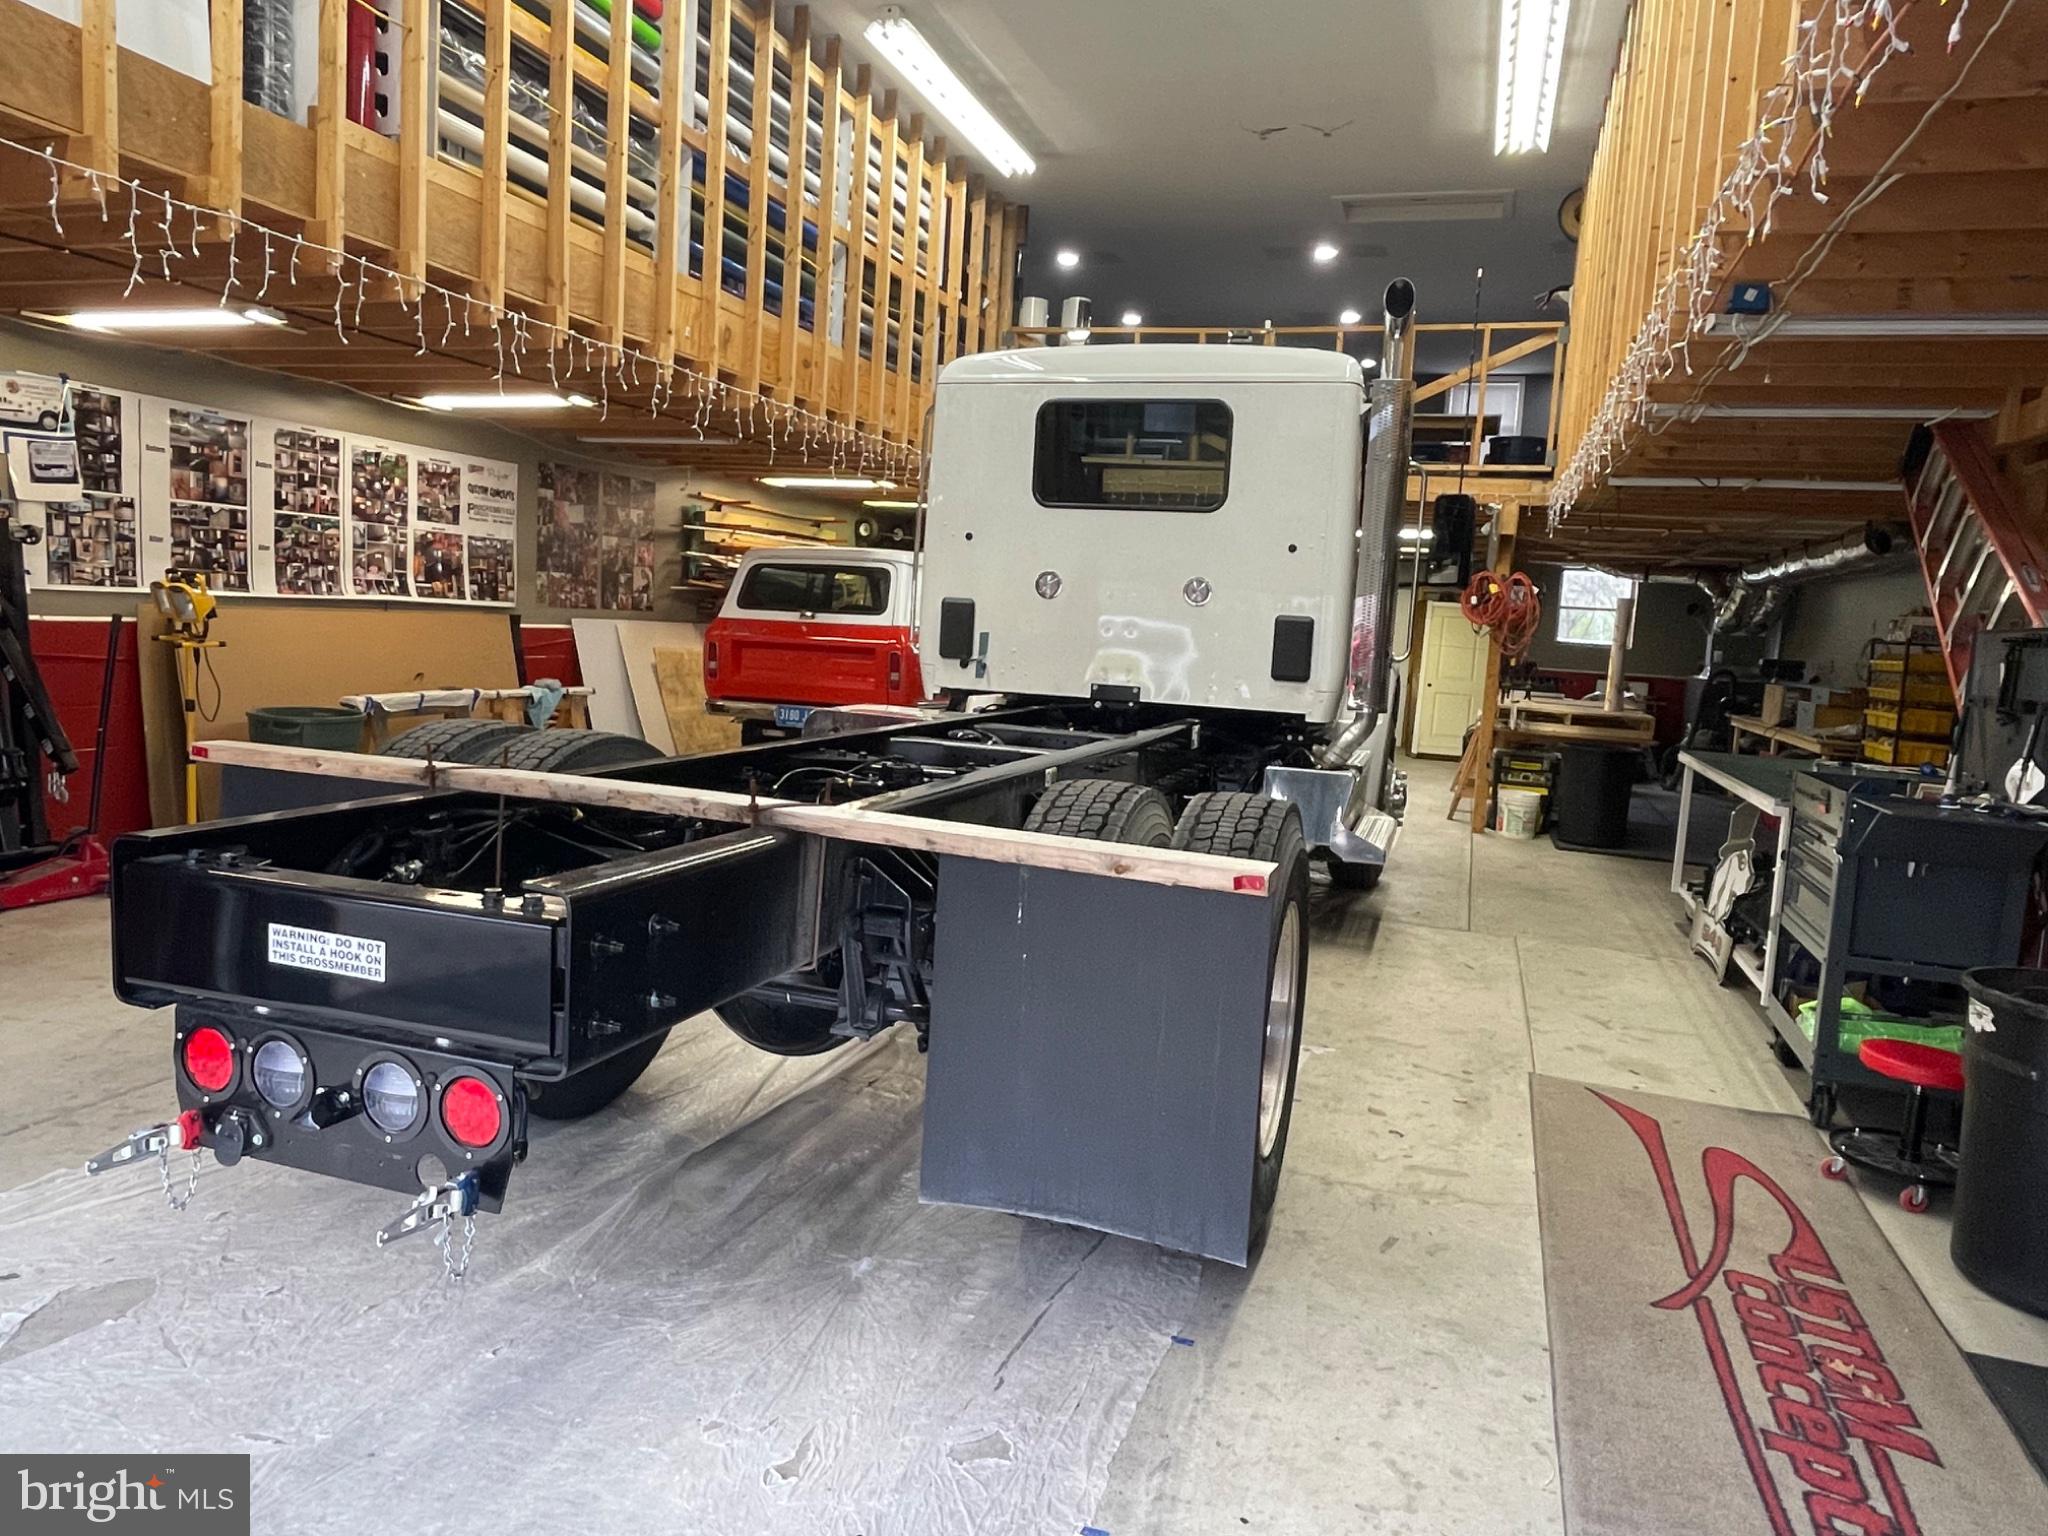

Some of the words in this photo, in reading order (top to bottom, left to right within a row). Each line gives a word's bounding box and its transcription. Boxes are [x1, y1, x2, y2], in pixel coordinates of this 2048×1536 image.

[272, 928, 330, 945] WARNING:
[335, 937, 352, 949] DO
[357, 941, 382, 954] NOT
[272, 939, 316, 955] INSTALL
[319, 947, 327, 956] A
[330, 948, 362, 962] HOOK
[366, 955, 382, 966] ON
[272, 950, 296, 963] THIS
[299, 955, 382, 977] CROSSMEMBER
